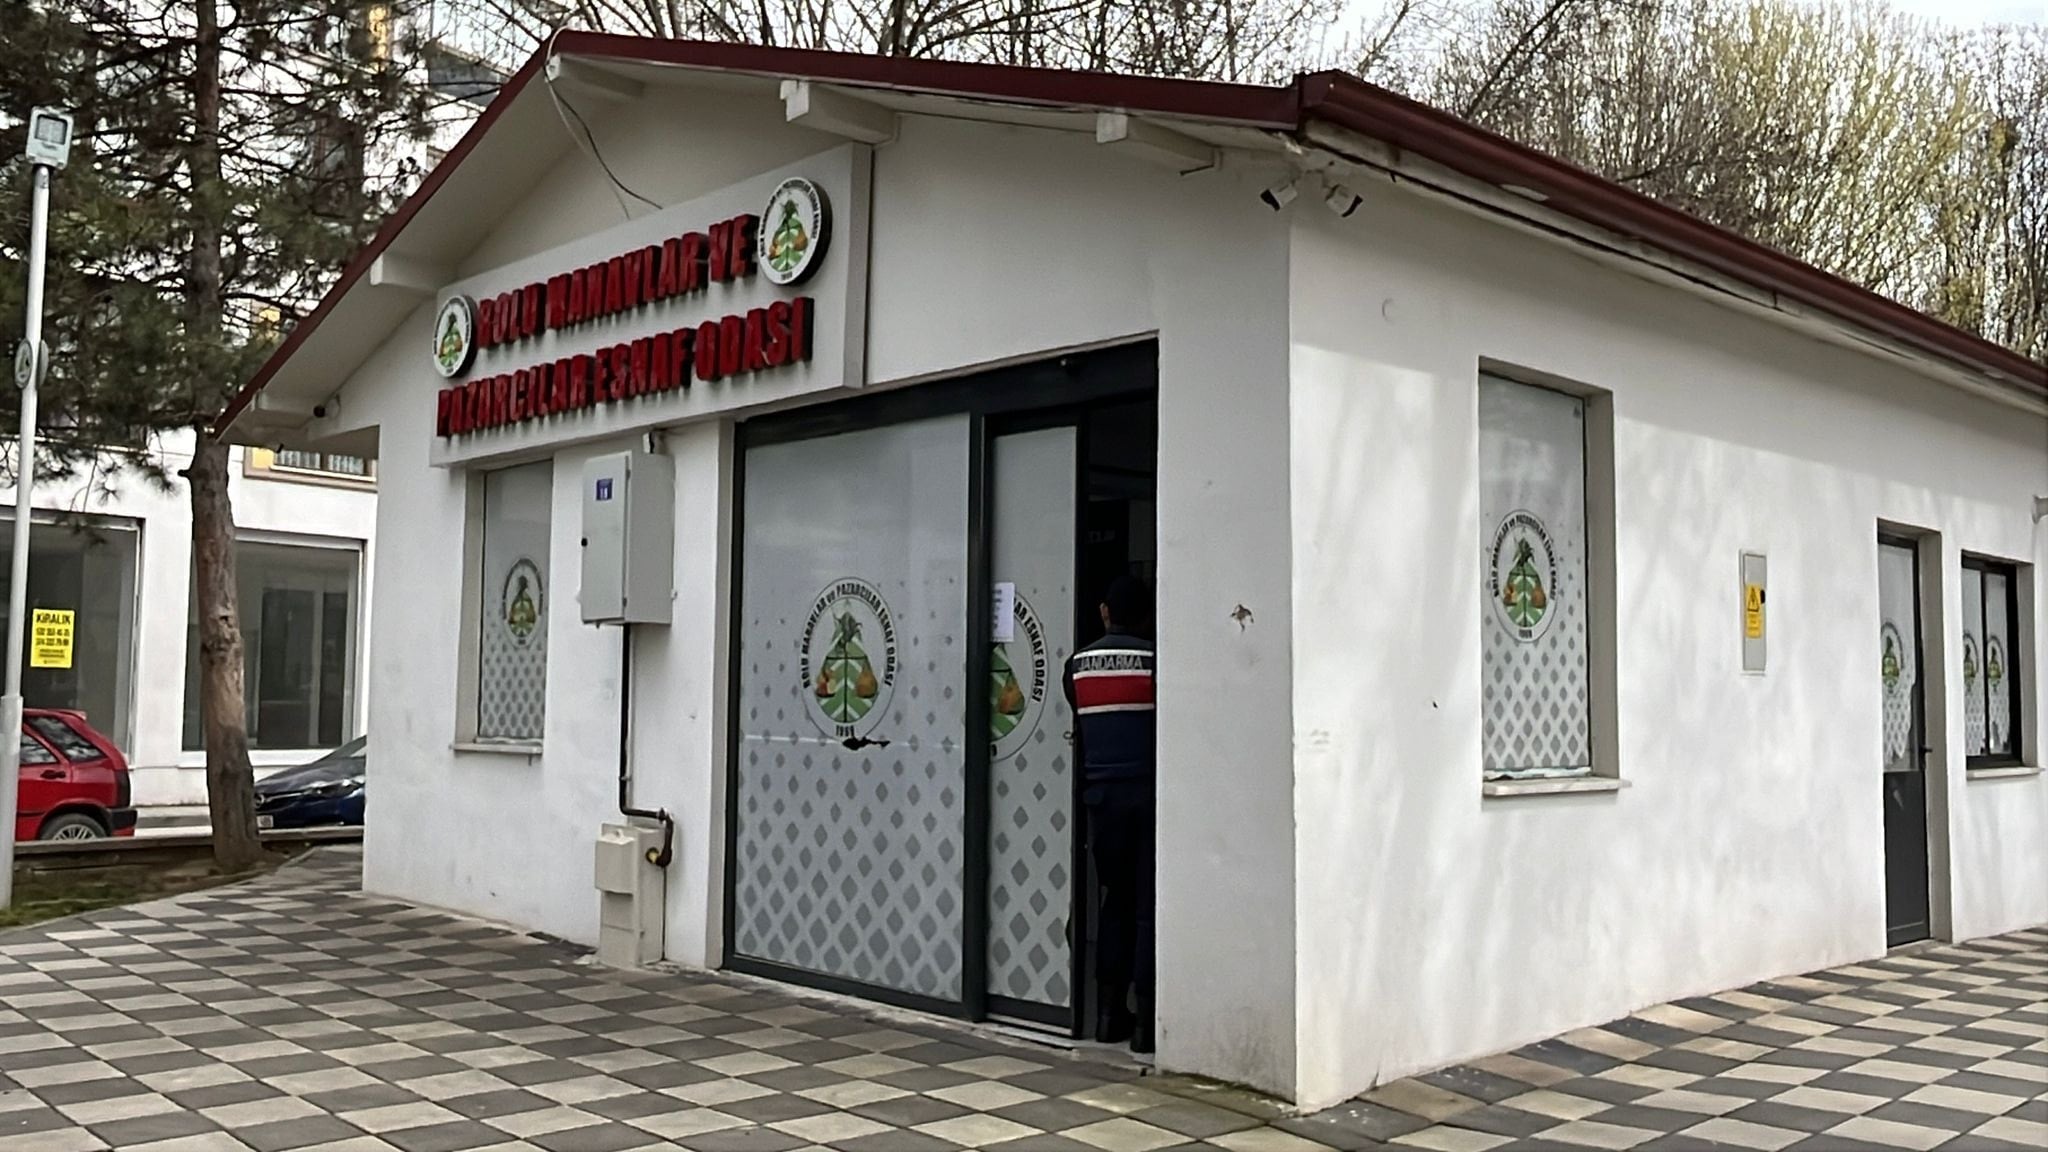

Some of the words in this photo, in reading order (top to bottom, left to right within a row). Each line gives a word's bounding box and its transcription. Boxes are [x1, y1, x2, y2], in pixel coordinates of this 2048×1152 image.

[477, 283, 545, 348] BOLU
[545, 232, 709, 330] MANAVLAR
[708, 214, 760, 282] VE
[437, 354, 594, 436] PAZARCILAR
[594, 328, 695, 400] ESNAF
[696, 297, 815, 381] ODASI
[1023, 617, 1044, 656] ESNAF
[1031, 660, 1046, 703] ODASI
[1078, 655, 1143, 671] JANDARMA
